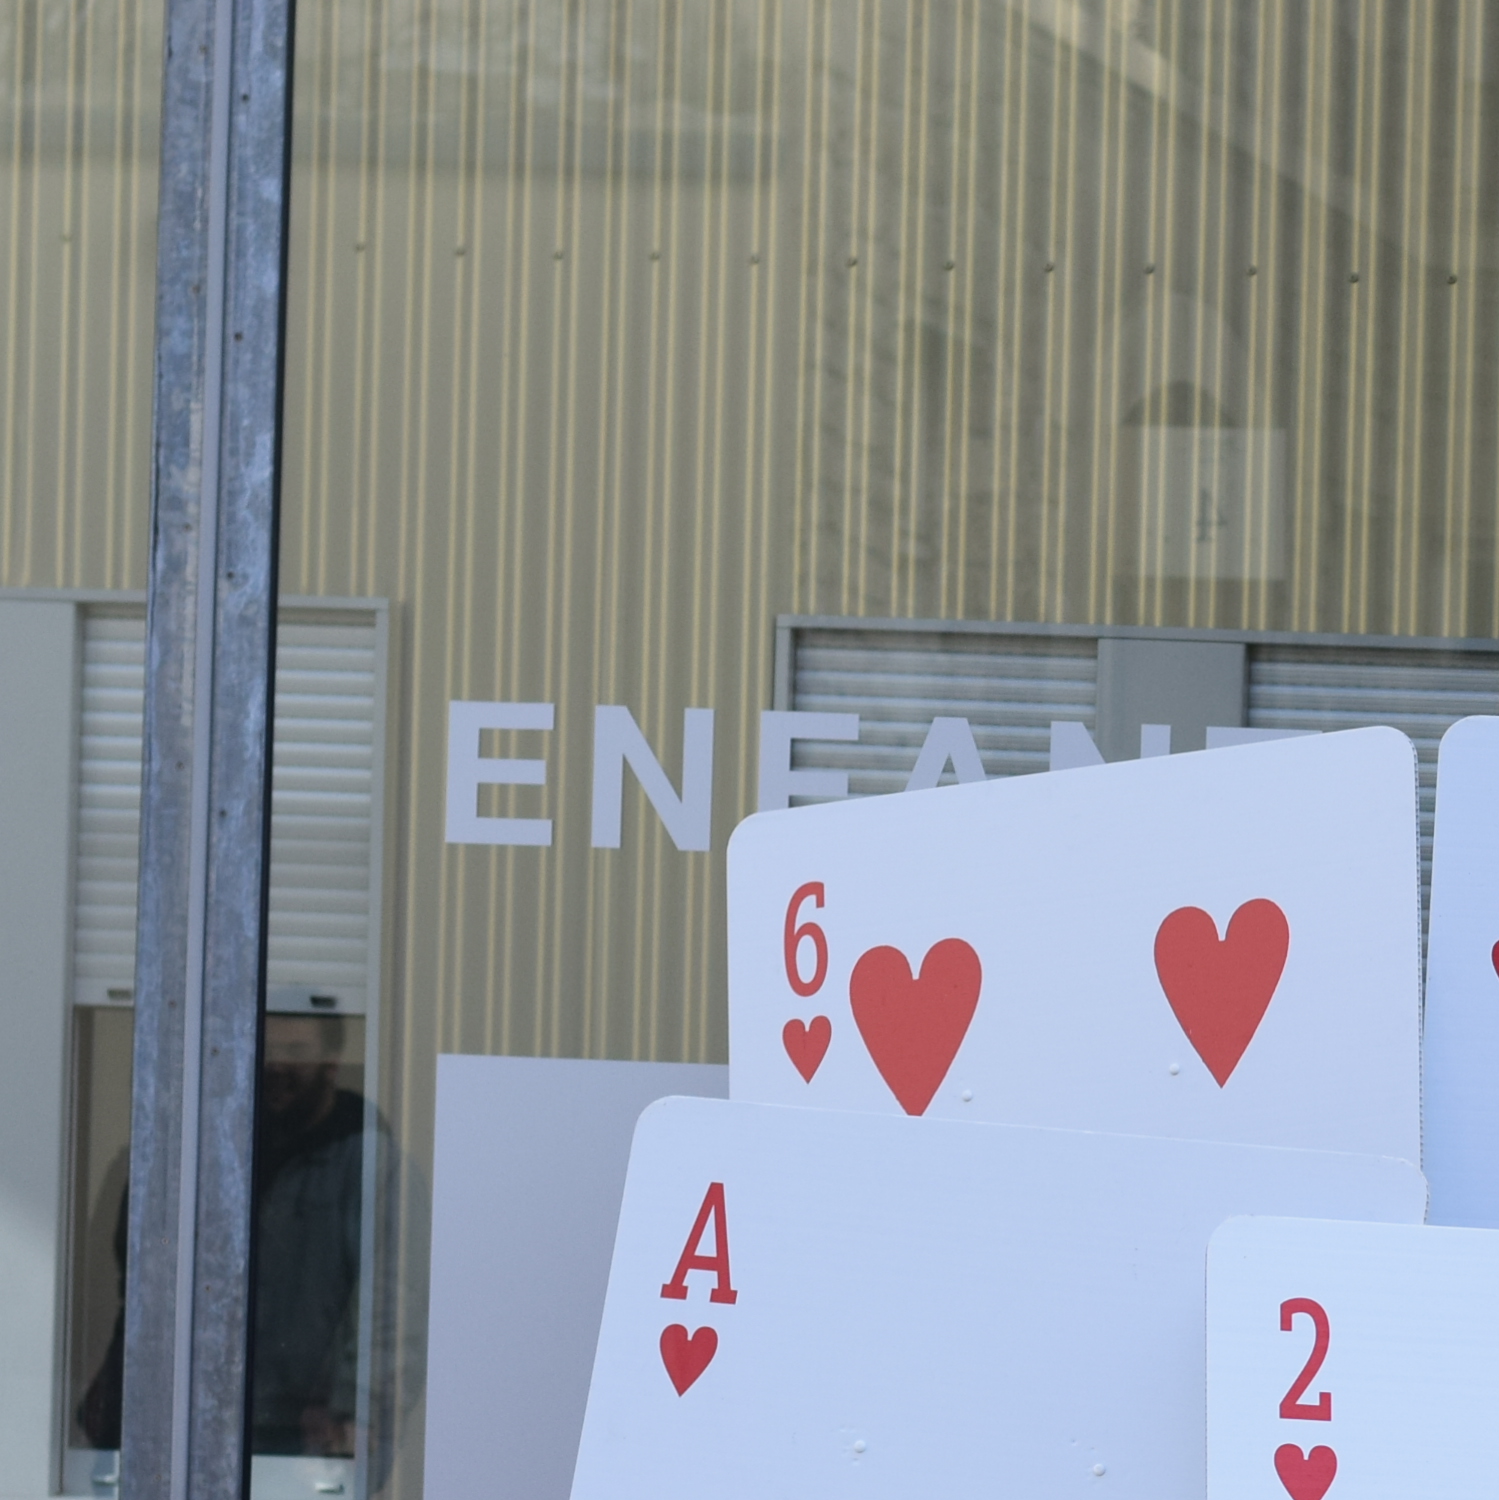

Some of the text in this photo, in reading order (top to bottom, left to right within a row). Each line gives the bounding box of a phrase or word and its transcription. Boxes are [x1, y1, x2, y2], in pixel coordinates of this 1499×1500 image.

[783, 881, 829, 998] 6
[660, 1181, 738, 1306] A
[1279, 1297, 1333, 1422] 2
